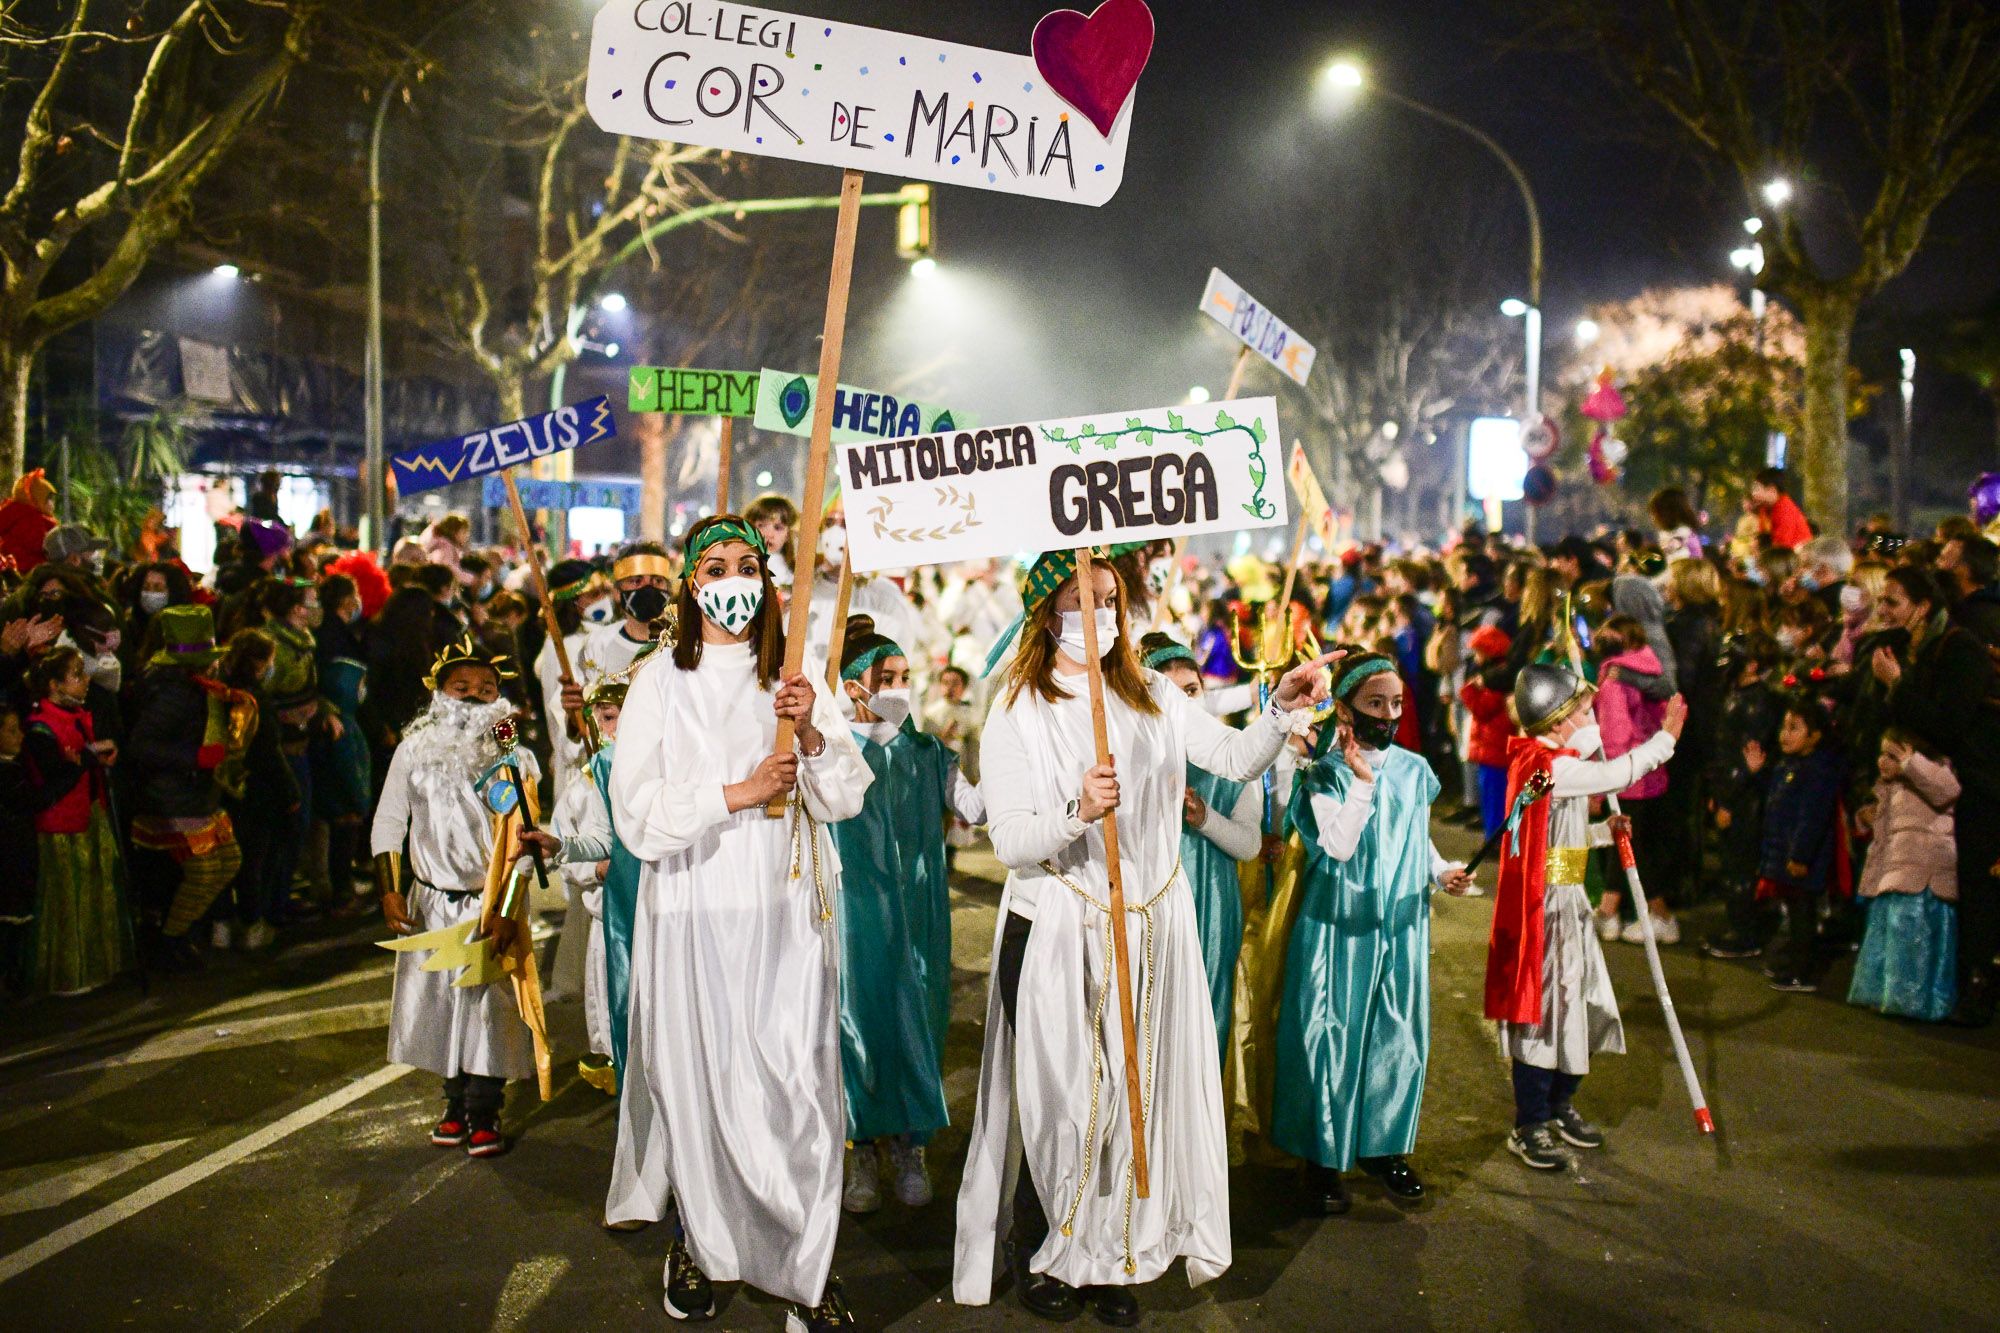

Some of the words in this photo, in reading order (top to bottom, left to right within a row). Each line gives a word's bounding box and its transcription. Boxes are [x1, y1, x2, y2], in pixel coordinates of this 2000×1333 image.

[643, 50, 803, 144] COR
[830, 101, 877, 151] DE
[653, 368, 759, 413] HERM
[832, 388, 921, 438] HERA
[462, 406, 580, 474] ZEUS
[846, 424, 1037, 491] MITOLOGIA
[1048, 450, 1219, 536] GREGA
